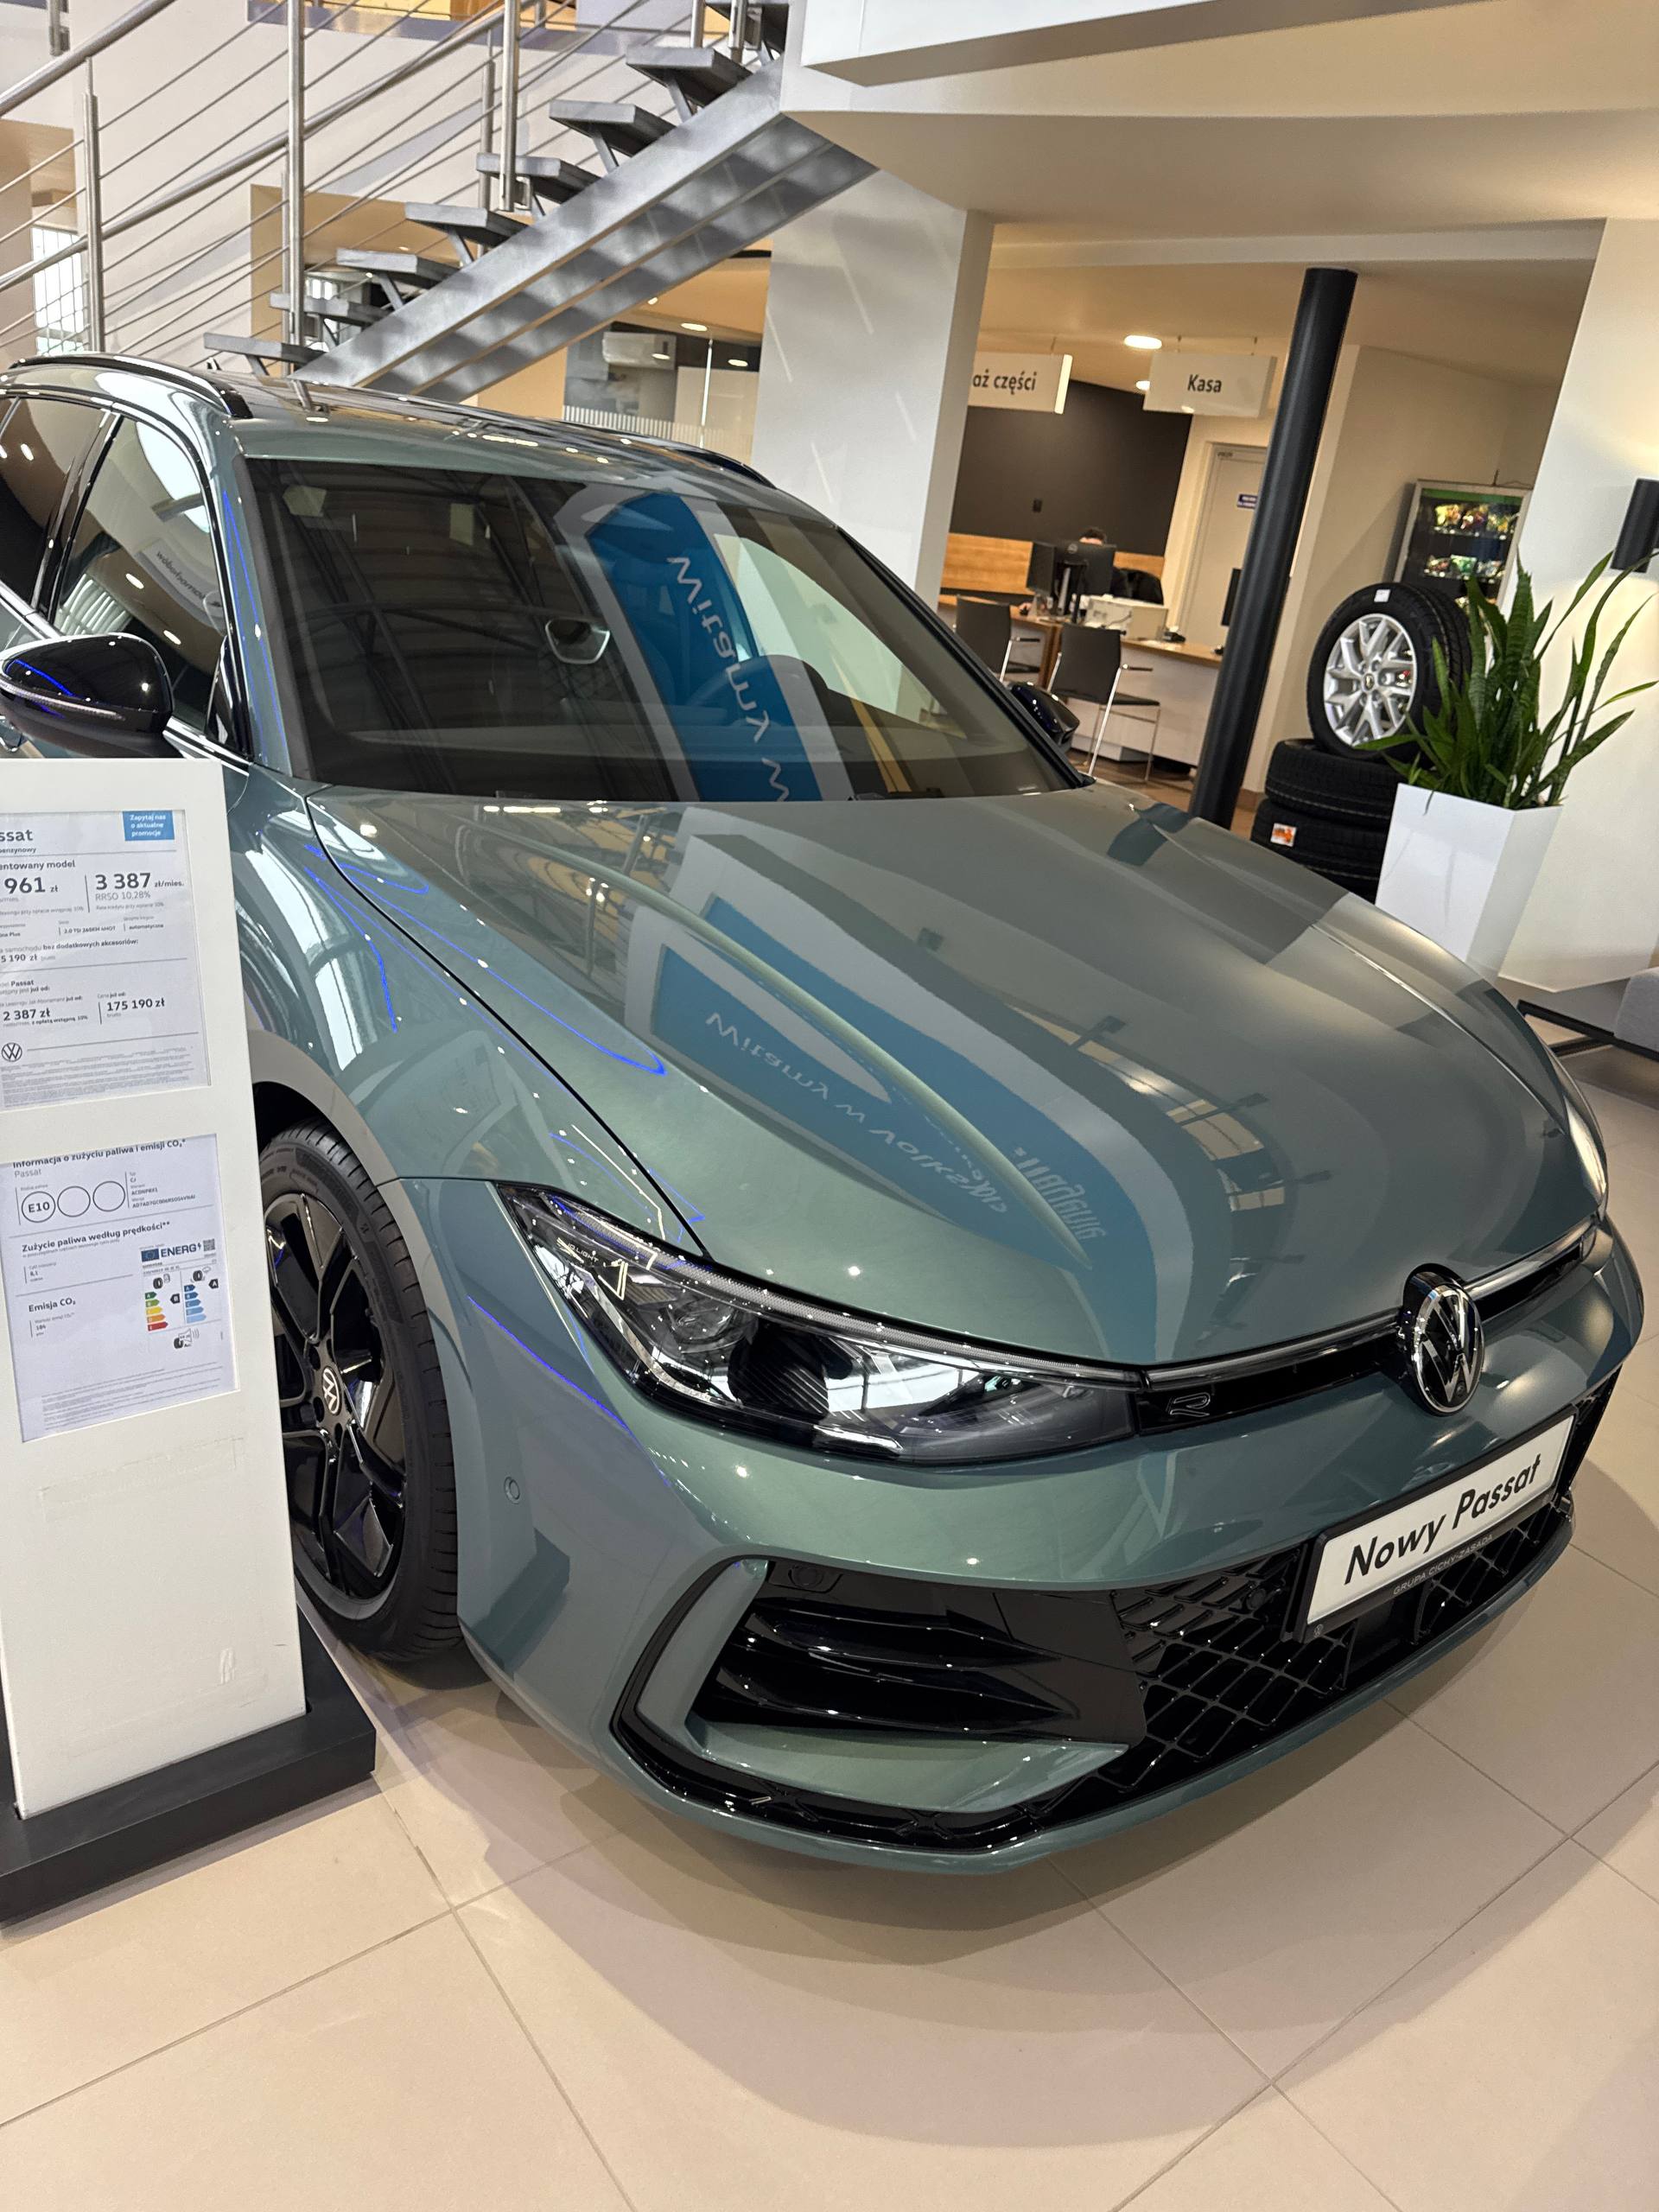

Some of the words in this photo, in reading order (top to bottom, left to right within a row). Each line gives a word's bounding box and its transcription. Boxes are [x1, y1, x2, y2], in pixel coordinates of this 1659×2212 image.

[994, 371, 1037, 395] części
[1186, 373, 1223, 394] Kasa
[47, 860, 76, 869] model
[3, 875, 46, 894] 961
[50, 884, 59, 893] zł
[95, 874, 108, 890] 3
[113, 872, 151, 890] 387
[95, 892, 119, 902] RRSO
[55, 940, 100, 950] dodatkowych
[9, 953, 27, 962] 190
[106, 1001, 129, 1012] 175
[131, 998, 154, 1009] 190
[155, 997, 165, 1007] zł
[39, 1007, 51, 1018] zł
[13, 1156, 62, 1169] Informacja
[71, 1150, 105, 1161] zużyciu
[105, 1146, 135, 1159] paliwa
[140, 1140, 166, 1151] emisji
[14, 1169, 41, 1178] Passat
[29, 1201, 51, 1214] E10
[22, 1240, 56, 1253] Zużycie
[57, 1236, 87, 1248] paliwa
[88, 1230, 121, 1242] według
[161, 1243, 197, 1257] ENERG
[29, 1300, 59, 1313] Emisja
[1343, 1513, 1447, 1586] Nowy
[1452, 1452, 1542, 1531] Passat
[1393, 1572, 1427, 1596] GRUPA
